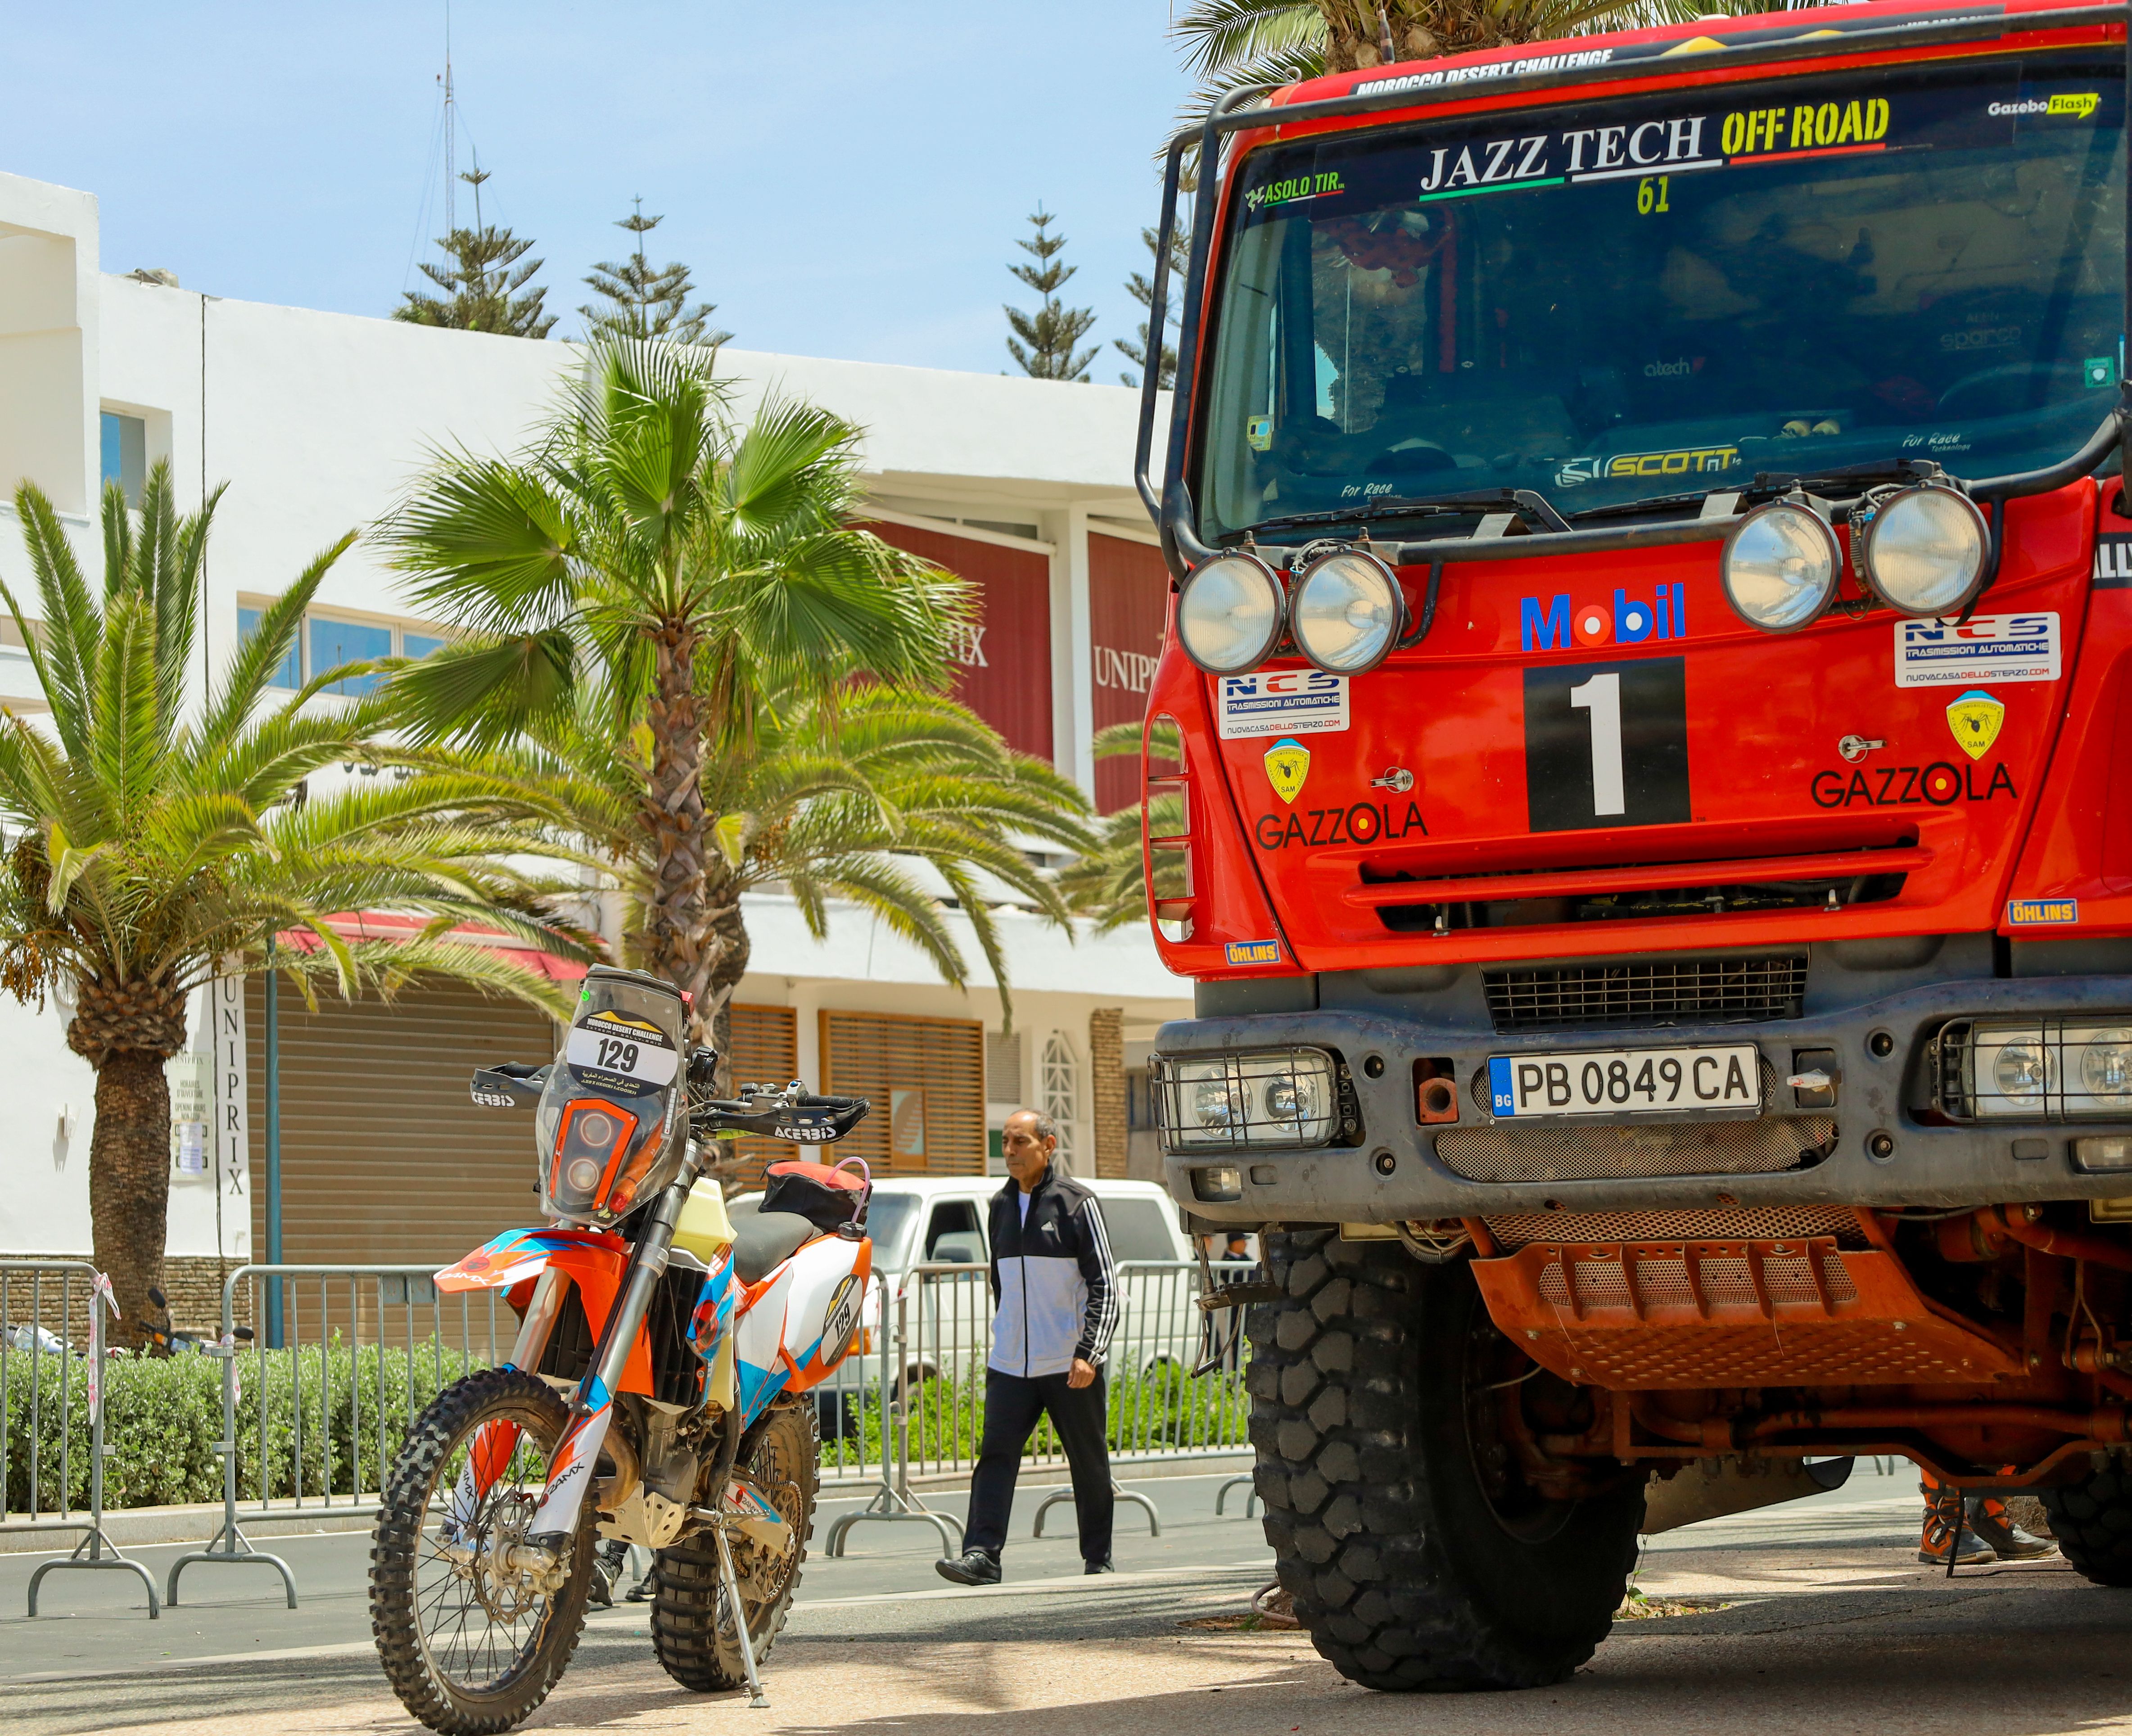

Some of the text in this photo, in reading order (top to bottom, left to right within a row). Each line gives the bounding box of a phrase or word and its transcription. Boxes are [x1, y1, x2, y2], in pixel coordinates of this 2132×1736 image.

[1513, 49, 1613, 74] CHALLENGE
[1421, 98, 1890, 192] JAZZ TECH OFF ROAD
[1264, 176, 1310, 203] ASOLO
[1314, 172, 1339, 193] TIR
[1637, 176, 1670, 215] 61
[1902, 432, 1960, 448] For Race
[1611, 448, 1738, 477] SCOTT
[1341, 483, 1393, 497] For Race
[1521, 583, 1685, 651] Mobil
[1906, 617, 2048, 642] NCS
[1906, 642, 2049, 657] TRASMISSIONI AUTOMATICHE
[1227, 672, 1340, 696] NCS
[1227, 695, 1340, 711] TRASMISSIONI AUTOMATICHE
[1269, 751, 1304, 760] AUTOMOBILISTICA
[1570, 673, 1624, 815] 1
[1811, 761, 2017, 809] GAZZOLA
[1256, 801, 1428, 850] GAZZOLA
[2013, 902, 2073, 922] ÖHLINS
[1229, 944, 1276, 962] ÖHLINS
[587, 1018, 663, 1042] MOROCCO DESERT CHALLENGE
[597, 1038, 639, 1072] 129
[224, 977, 244, 1195] UNIPRIX
[1518, 1055, 1749, 1108] PB 0849 CA
[1495, 1094, 1511, 1107] BG
[835, 1302, 850, 1342] 129
[548, 1461, 585, 1495] 24MX
